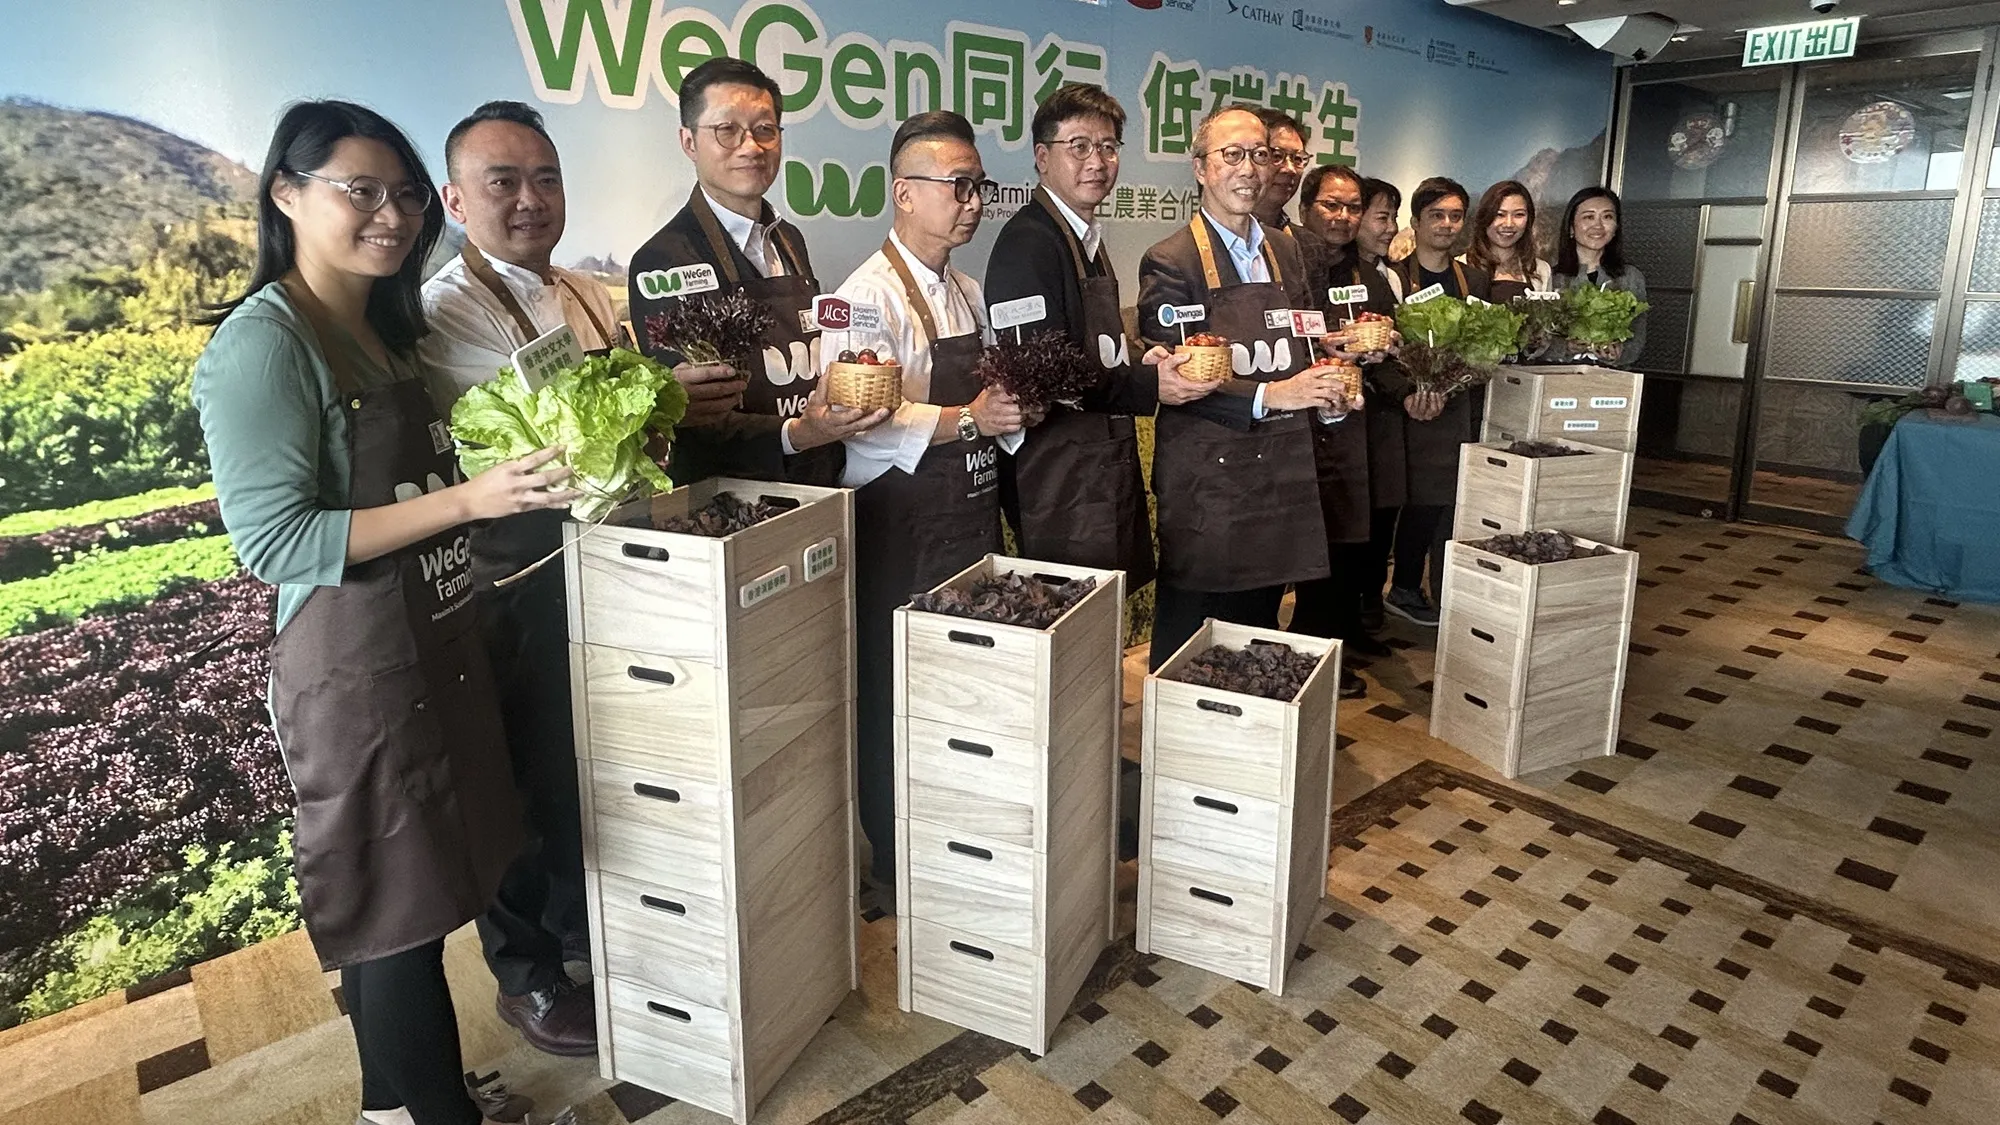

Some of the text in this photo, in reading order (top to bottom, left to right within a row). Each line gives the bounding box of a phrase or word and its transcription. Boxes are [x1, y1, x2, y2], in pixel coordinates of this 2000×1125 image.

[1242, 4, 1284, 26] CATHAY
[1748, 22, 1853, 63] EXIT 出口
[682, 268, 712, 281] WeGen
[819, 304, 849, 322] MCS
[852, 312, 880, 324] Catering
[1175, 309, 1204, 320] Towngas
[524, 332, 572, 370] 香港中文大學
